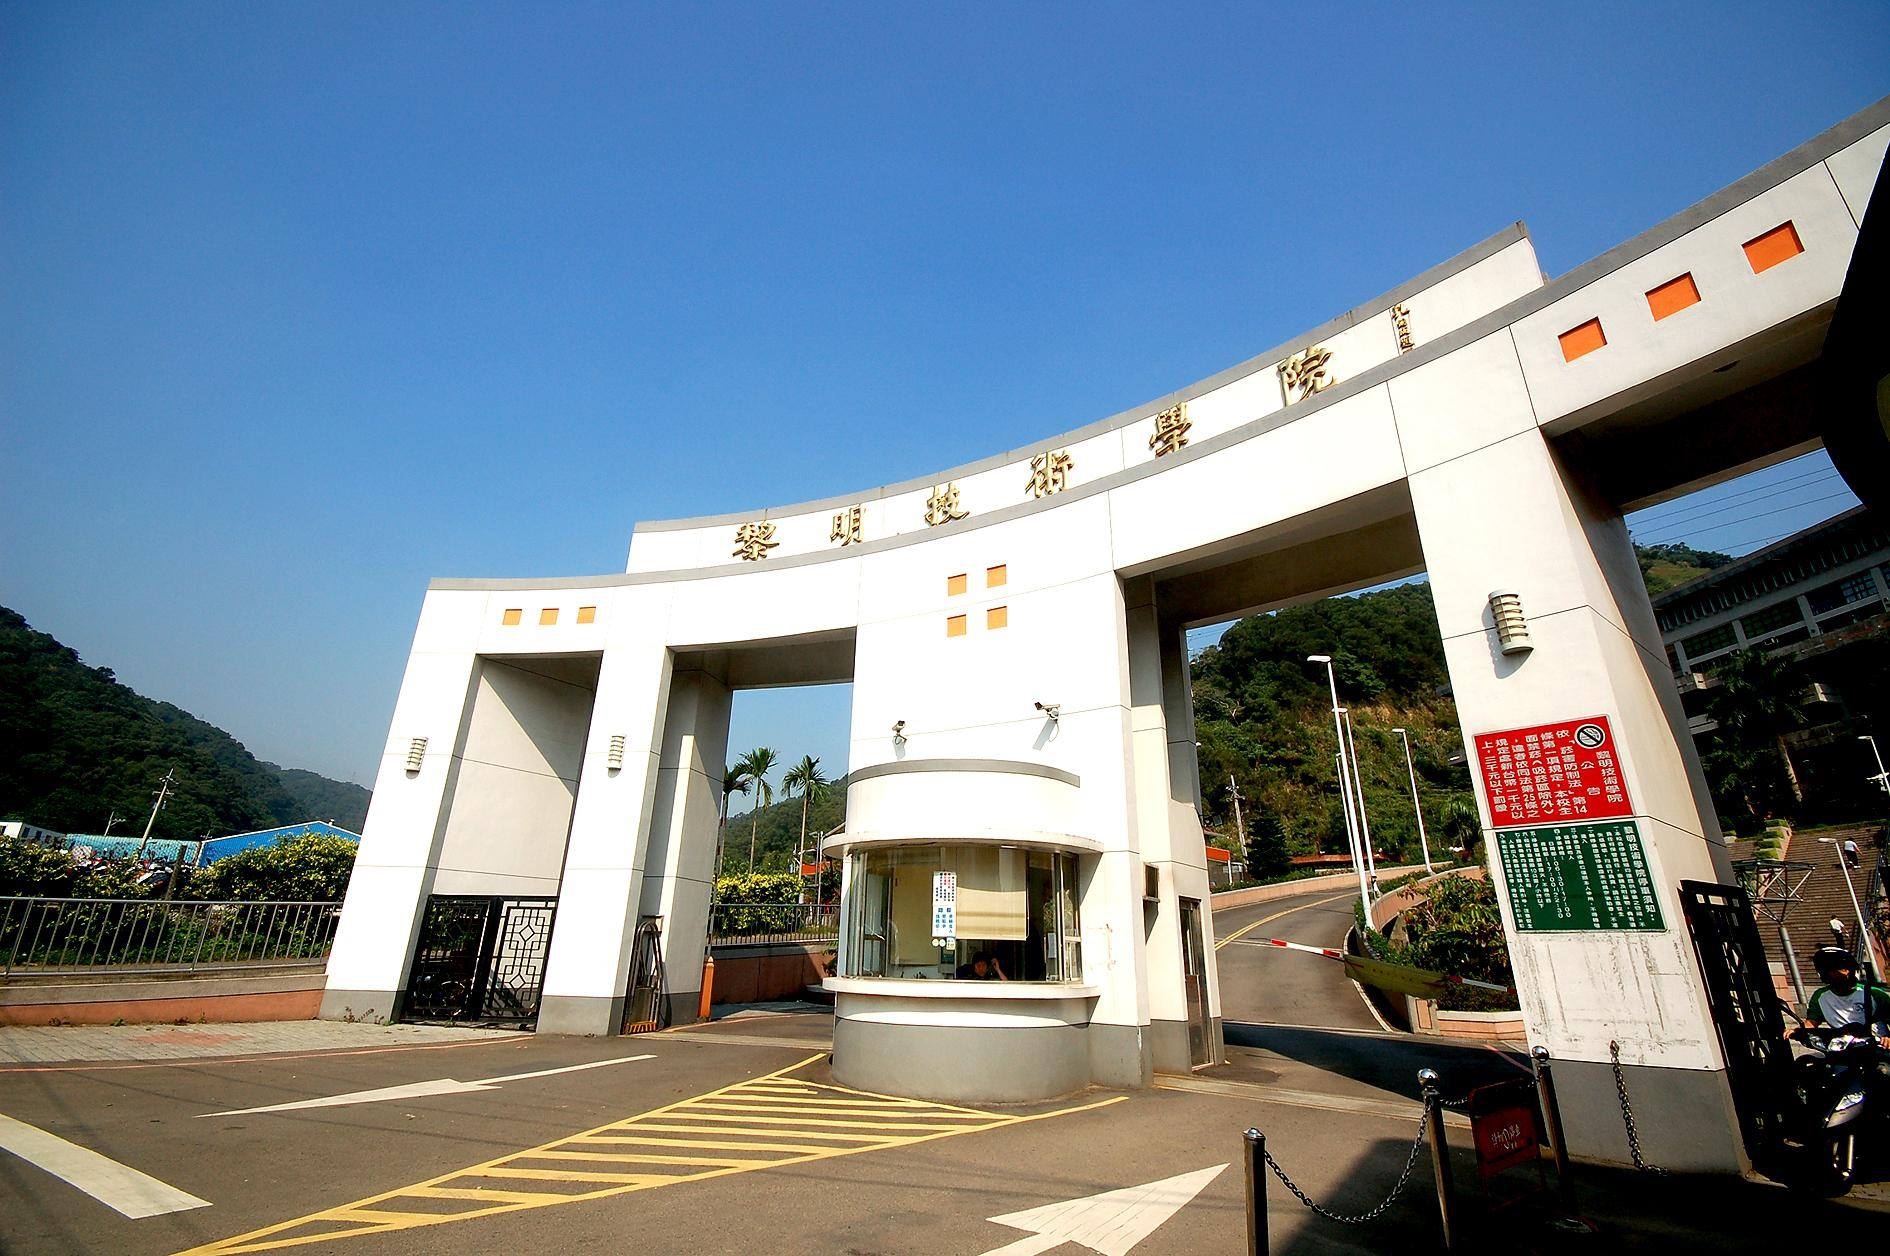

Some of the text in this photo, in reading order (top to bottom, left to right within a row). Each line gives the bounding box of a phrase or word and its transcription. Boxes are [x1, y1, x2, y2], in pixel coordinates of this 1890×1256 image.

[731, 344, 1338, 562] 黎明技術學院
[1579, 760, 1601, 795] 公告
[1595, 750, 1623, 802] 黎明技術學院
